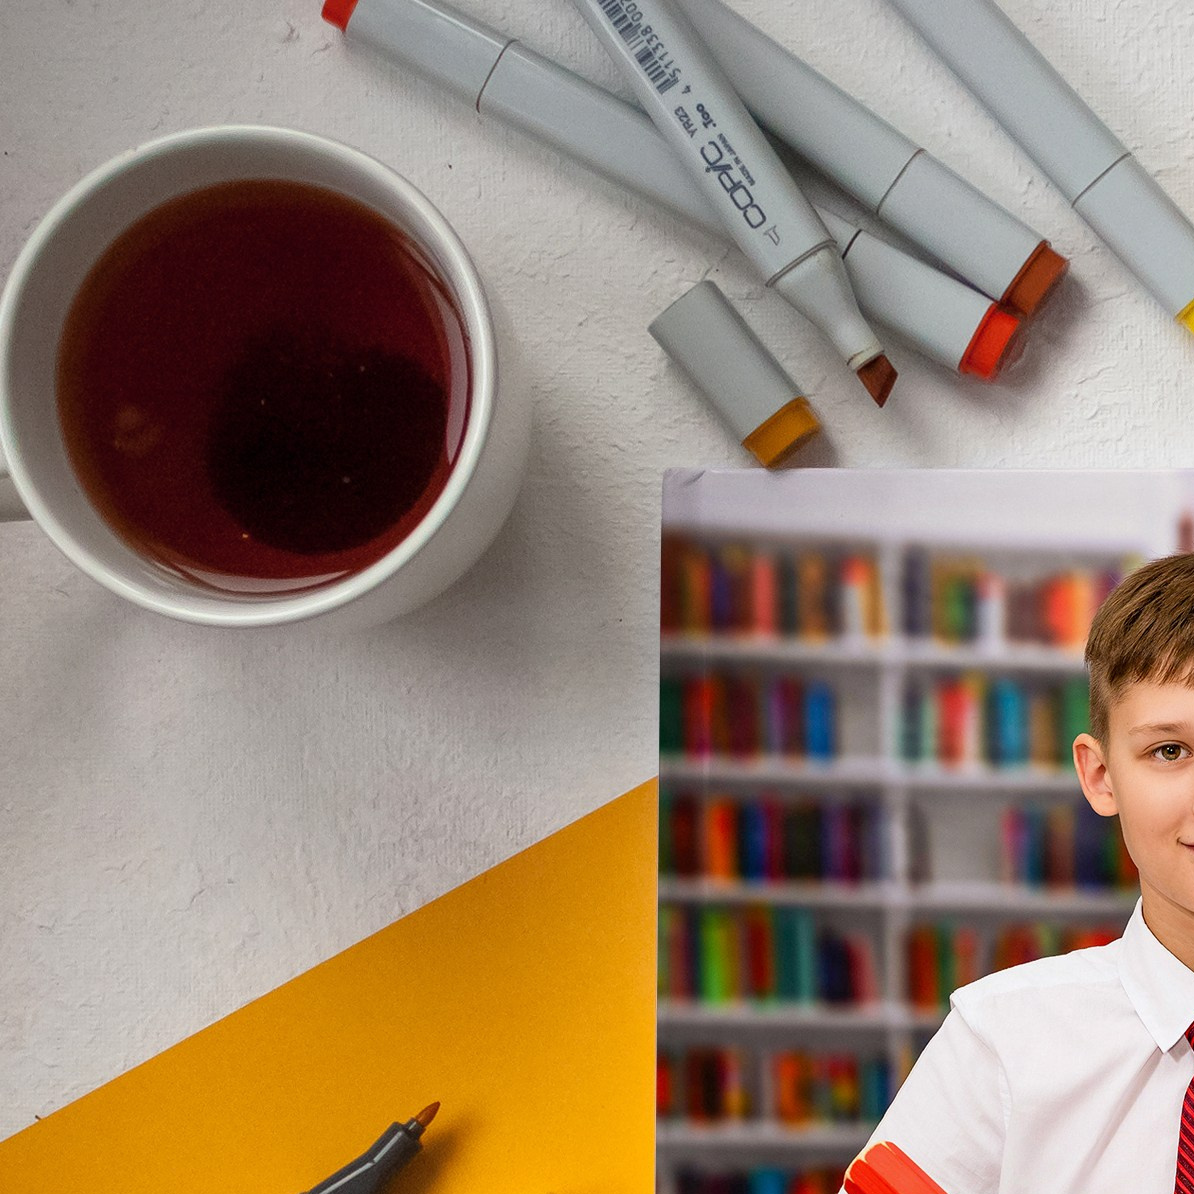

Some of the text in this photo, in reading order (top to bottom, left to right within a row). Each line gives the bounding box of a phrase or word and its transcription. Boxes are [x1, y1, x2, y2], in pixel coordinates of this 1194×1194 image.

[640, 25, 682, 81] 511338
[674, 106, 698, 138] YR23
[700, 140, 767, 229] COPIC
